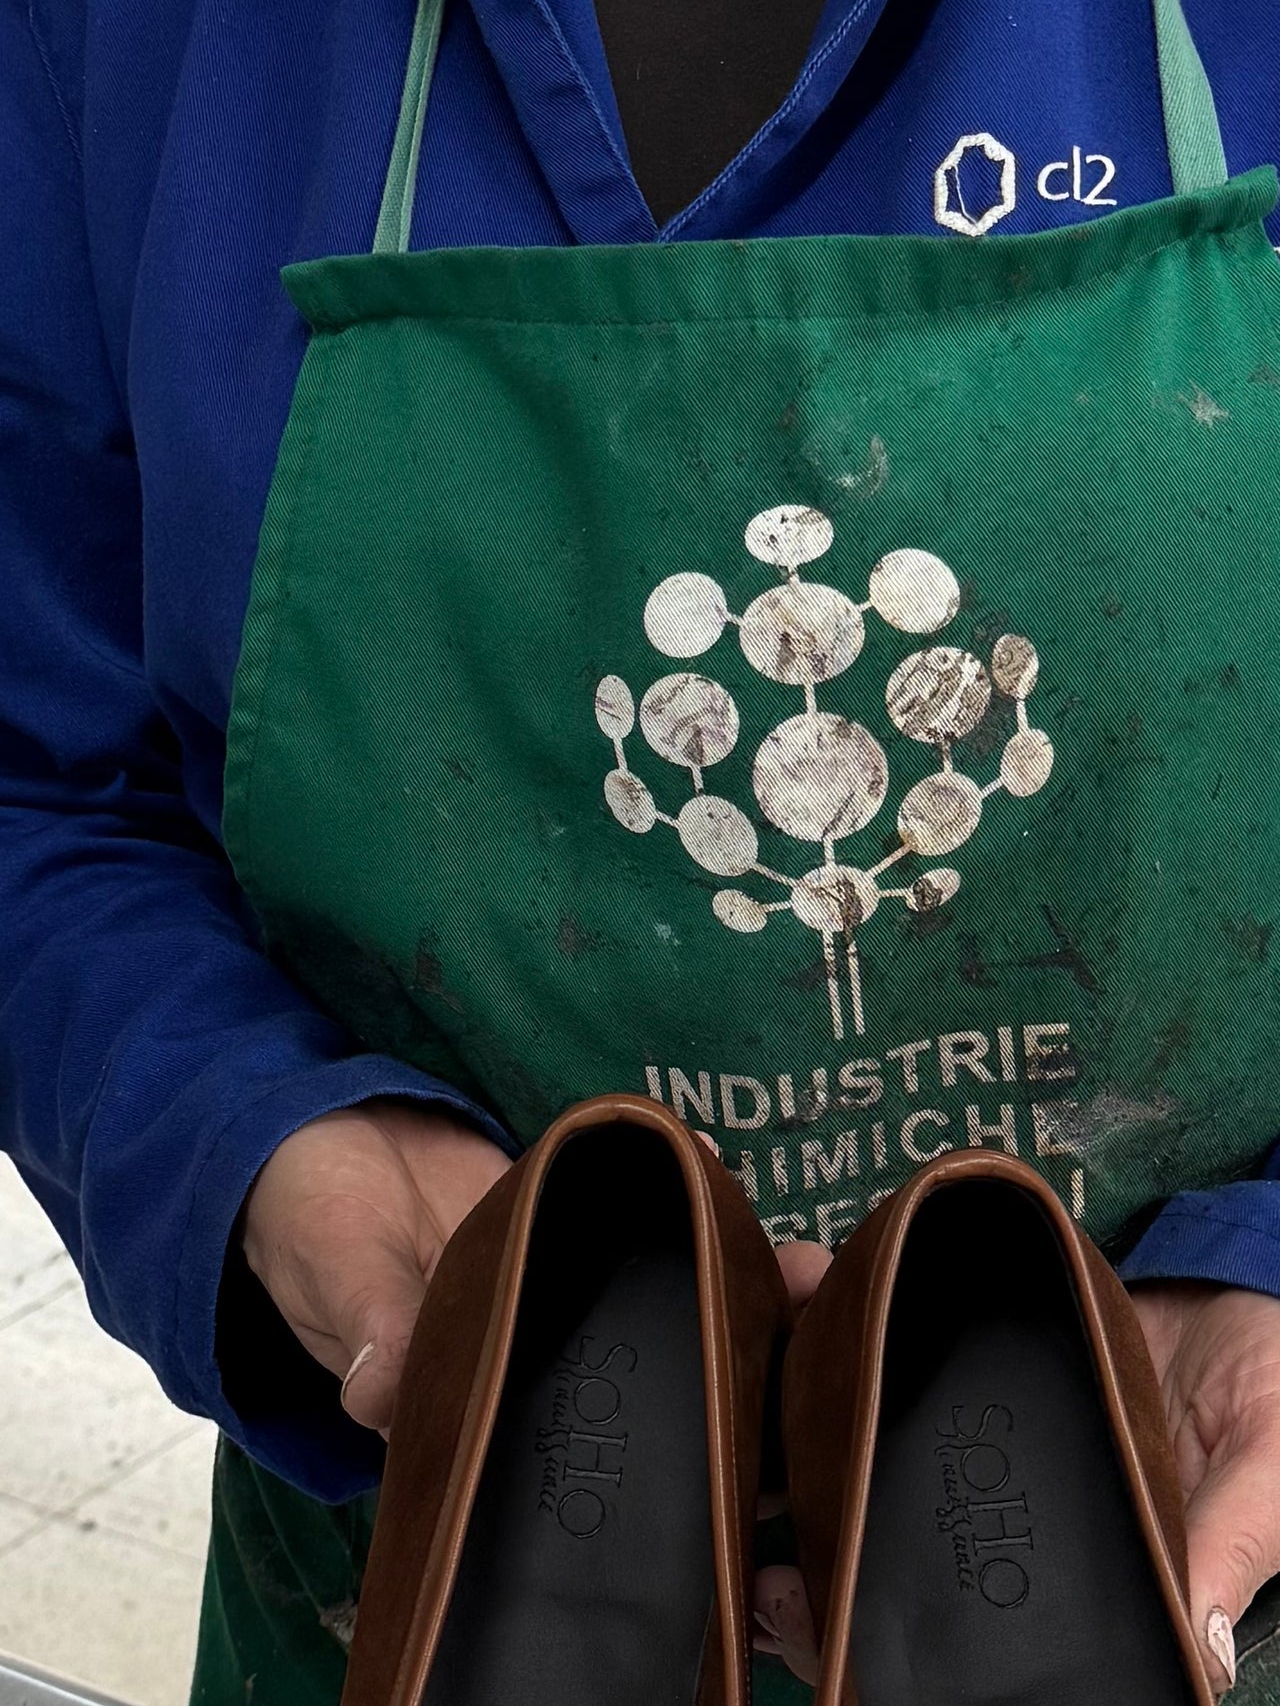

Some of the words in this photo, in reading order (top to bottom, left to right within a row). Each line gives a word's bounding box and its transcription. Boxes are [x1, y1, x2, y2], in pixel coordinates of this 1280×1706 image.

[644, 1022, 1078, 1130] INDUSTRIE
[717, 1099, 1080, 1202] HIMICHE
[557, 1335, 638, 1540] SOHO
[951, 1403, 1034, 1610] SOHO
